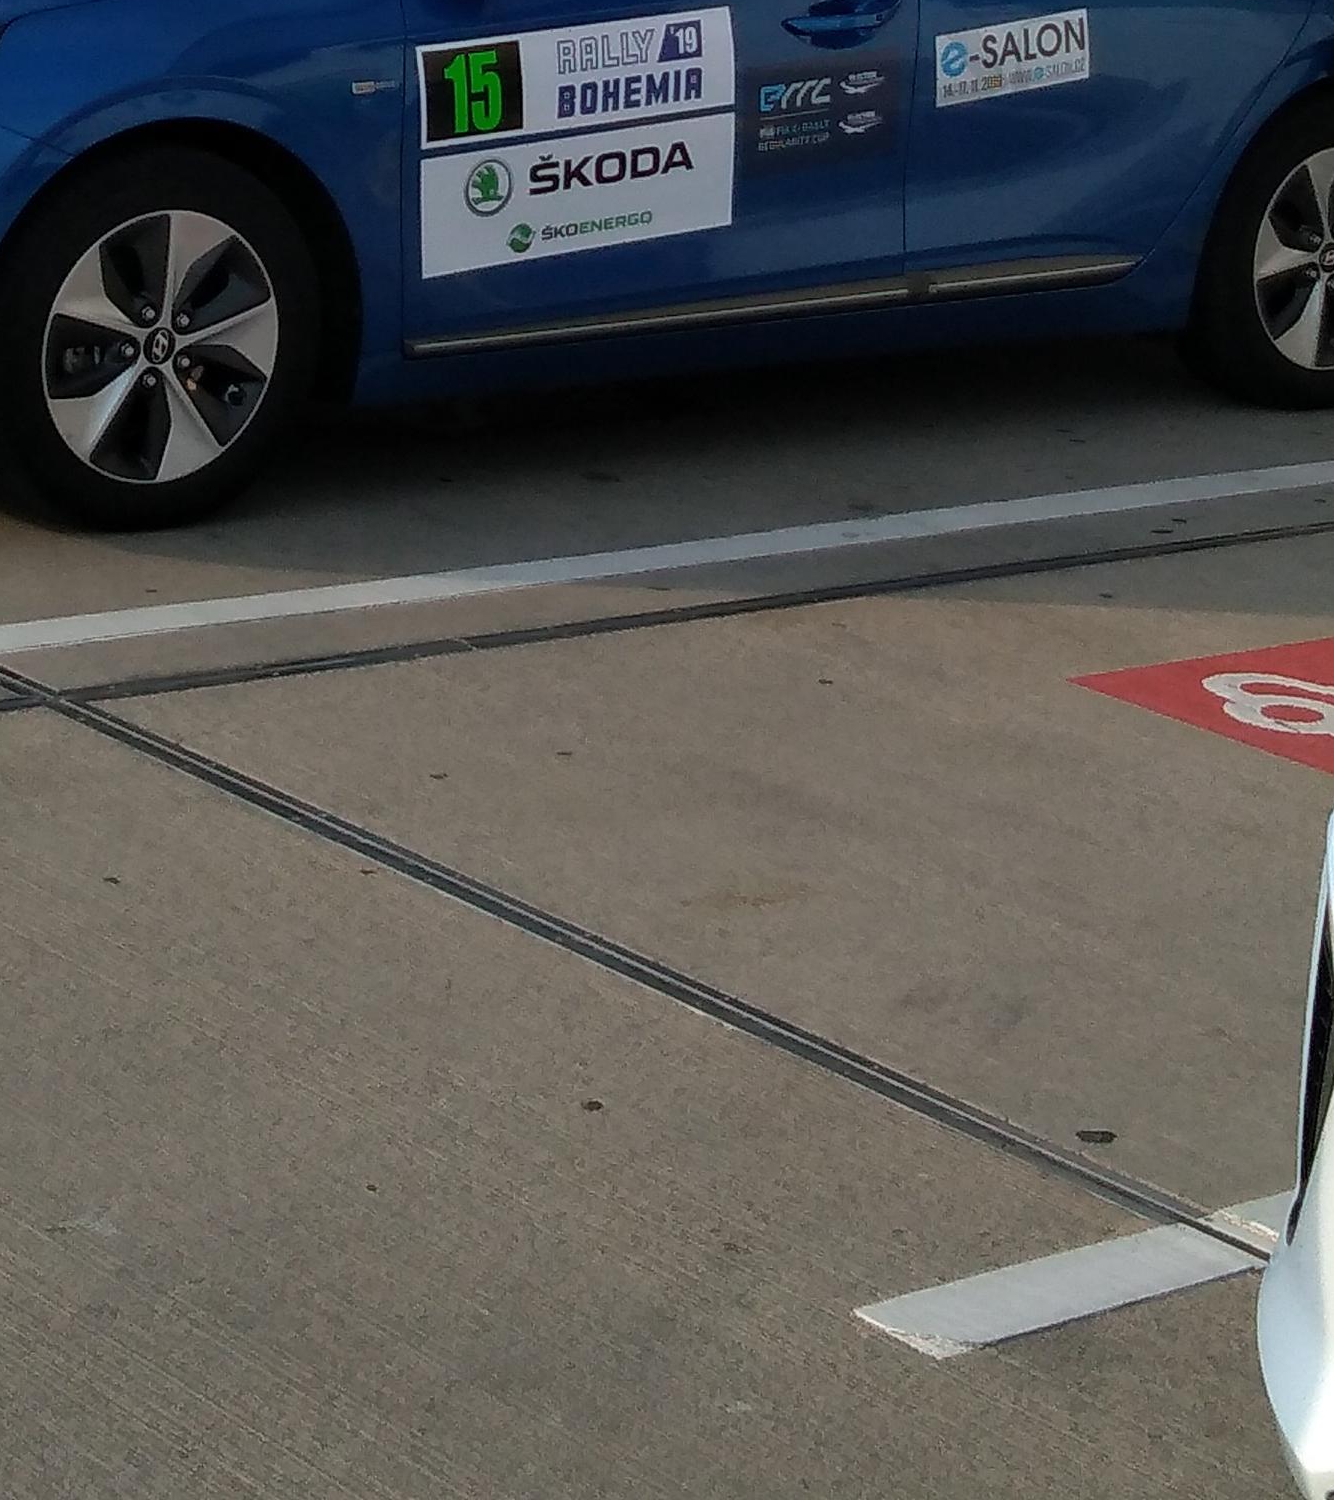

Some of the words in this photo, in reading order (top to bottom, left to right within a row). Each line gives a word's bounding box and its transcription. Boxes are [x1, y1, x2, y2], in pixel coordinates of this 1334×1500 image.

[557, 28, 656, 75] RALLY
[443, 50, 503, 134] 15
[557, 68, 703, 120] BOHEMIA
[529, 141, 695, 196] ŠKODA
[541, 210, 653, 241] ŠKOENERGO
